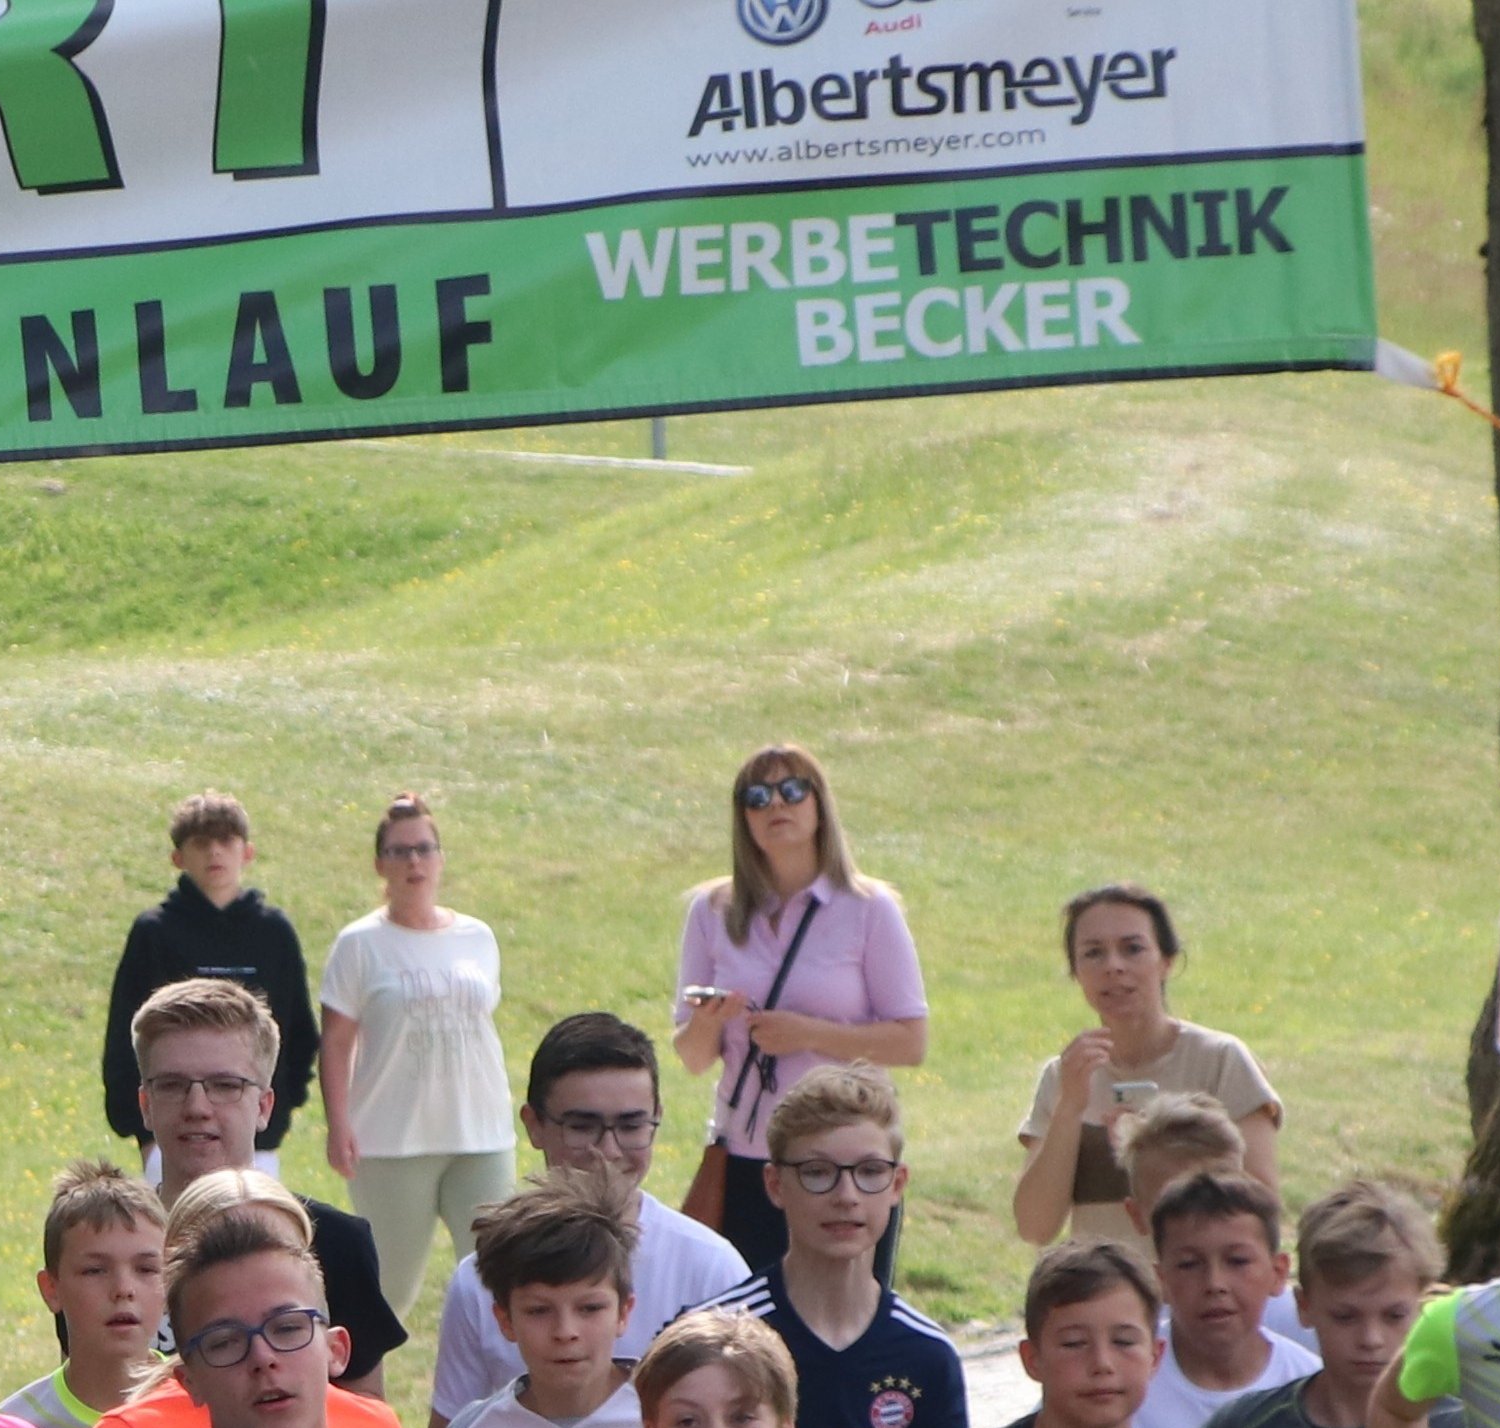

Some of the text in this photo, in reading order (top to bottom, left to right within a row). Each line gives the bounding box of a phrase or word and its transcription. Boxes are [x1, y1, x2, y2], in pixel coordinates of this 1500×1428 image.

[863, 14, 923, 35] Audi
[686, 46, 1177, 137] Albertsmeyer
[686, 125, 1047, 169] www.albertsmeyer.com
[585, 185, 1295, 301] WERBETECHNIK
[795, 277, 1141, 367] BECKER
